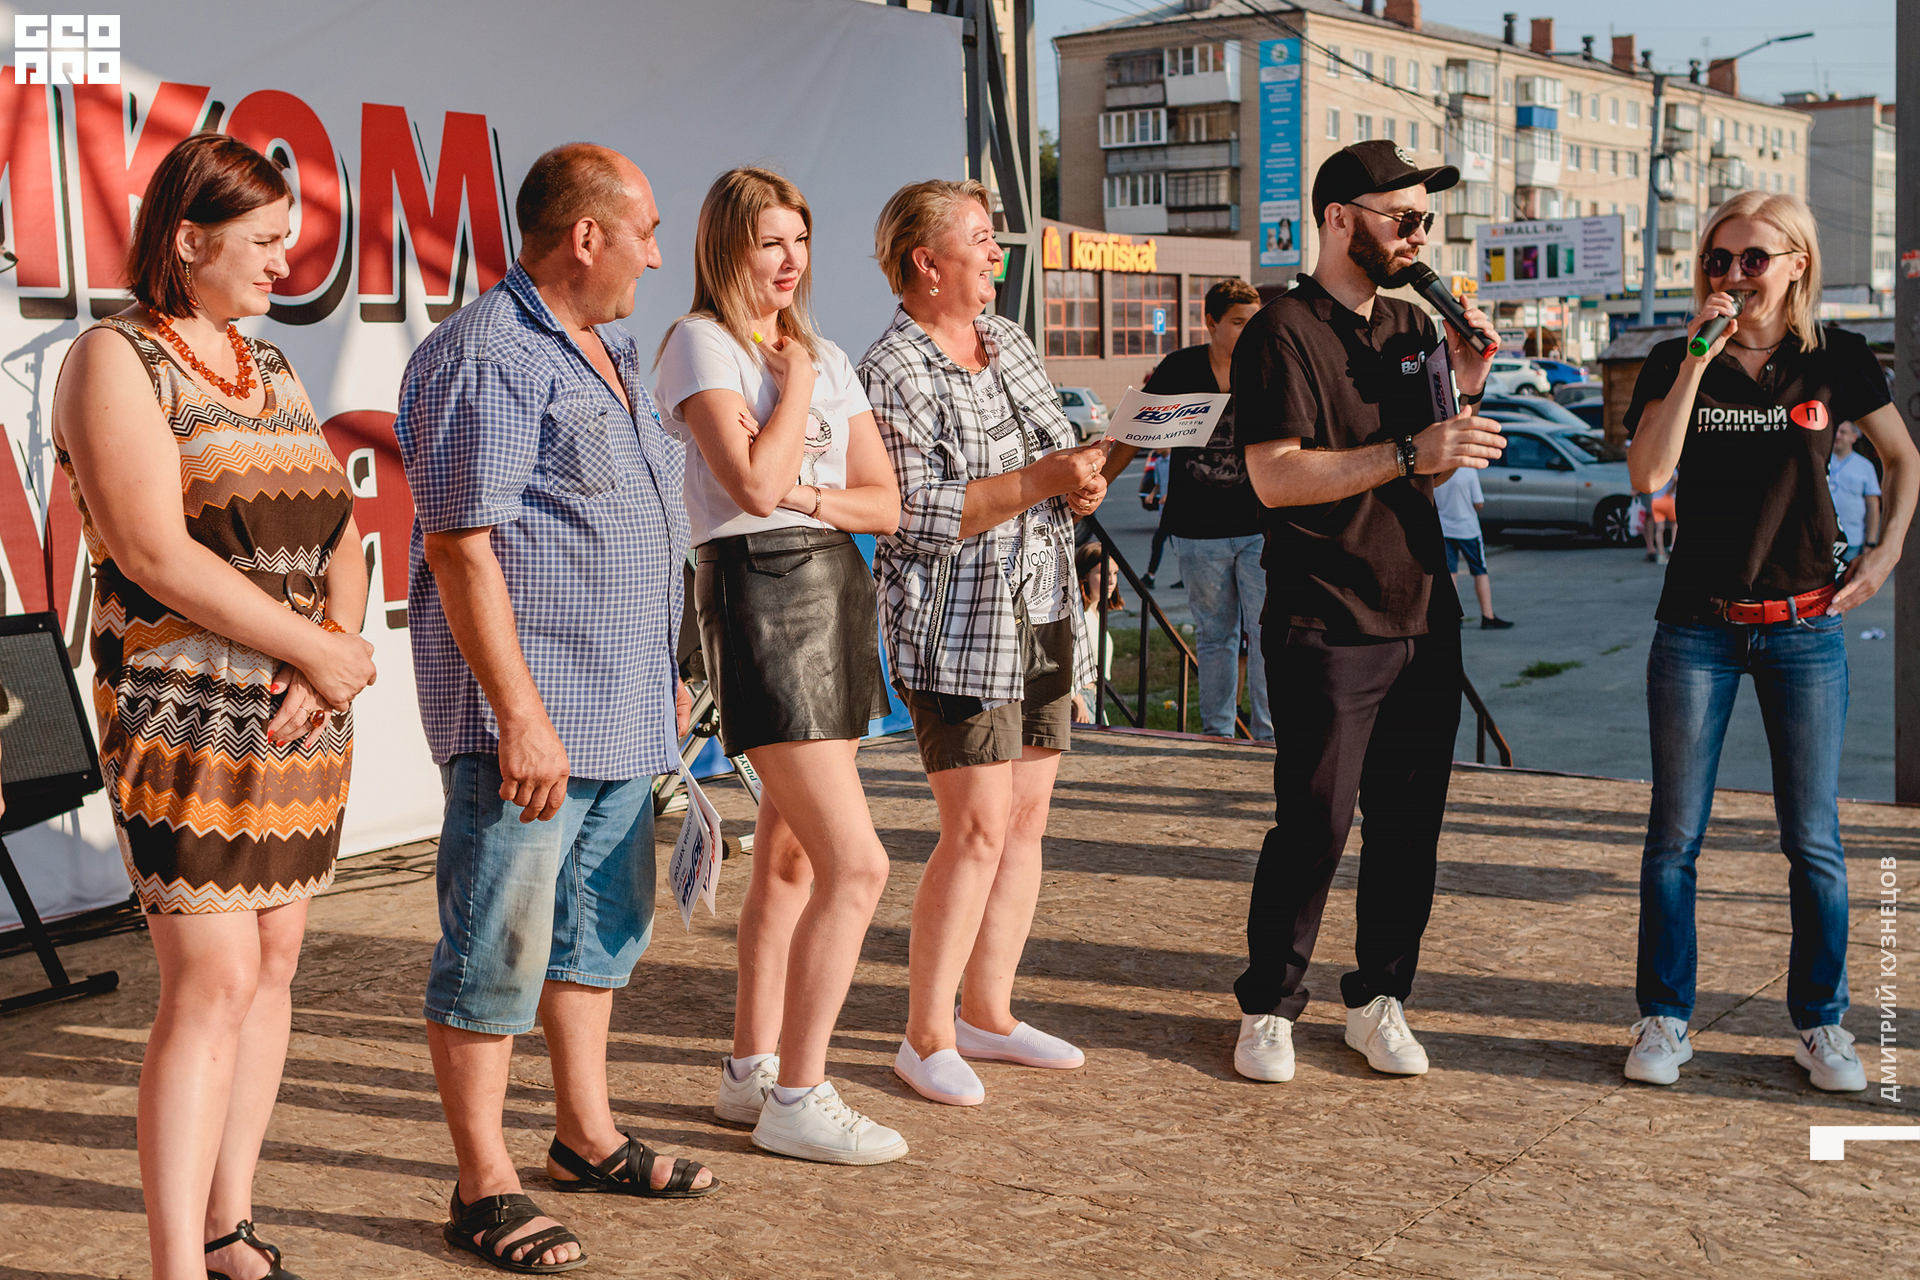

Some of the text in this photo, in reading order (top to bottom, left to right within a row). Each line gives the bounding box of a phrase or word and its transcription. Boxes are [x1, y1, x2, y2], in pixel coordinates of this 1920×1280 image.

[1072, 231, 1157, 273] konfiskat
[1139, 403, 1181, 412] INTER
[1698, 405, 1788, 425] ПОЛНЫЙ
[1125, 428, 1197, 442] ВОЛНА ХИТОВ
[1698, 424, 1788, 433] УТРЕННЕЕ ШОУ
